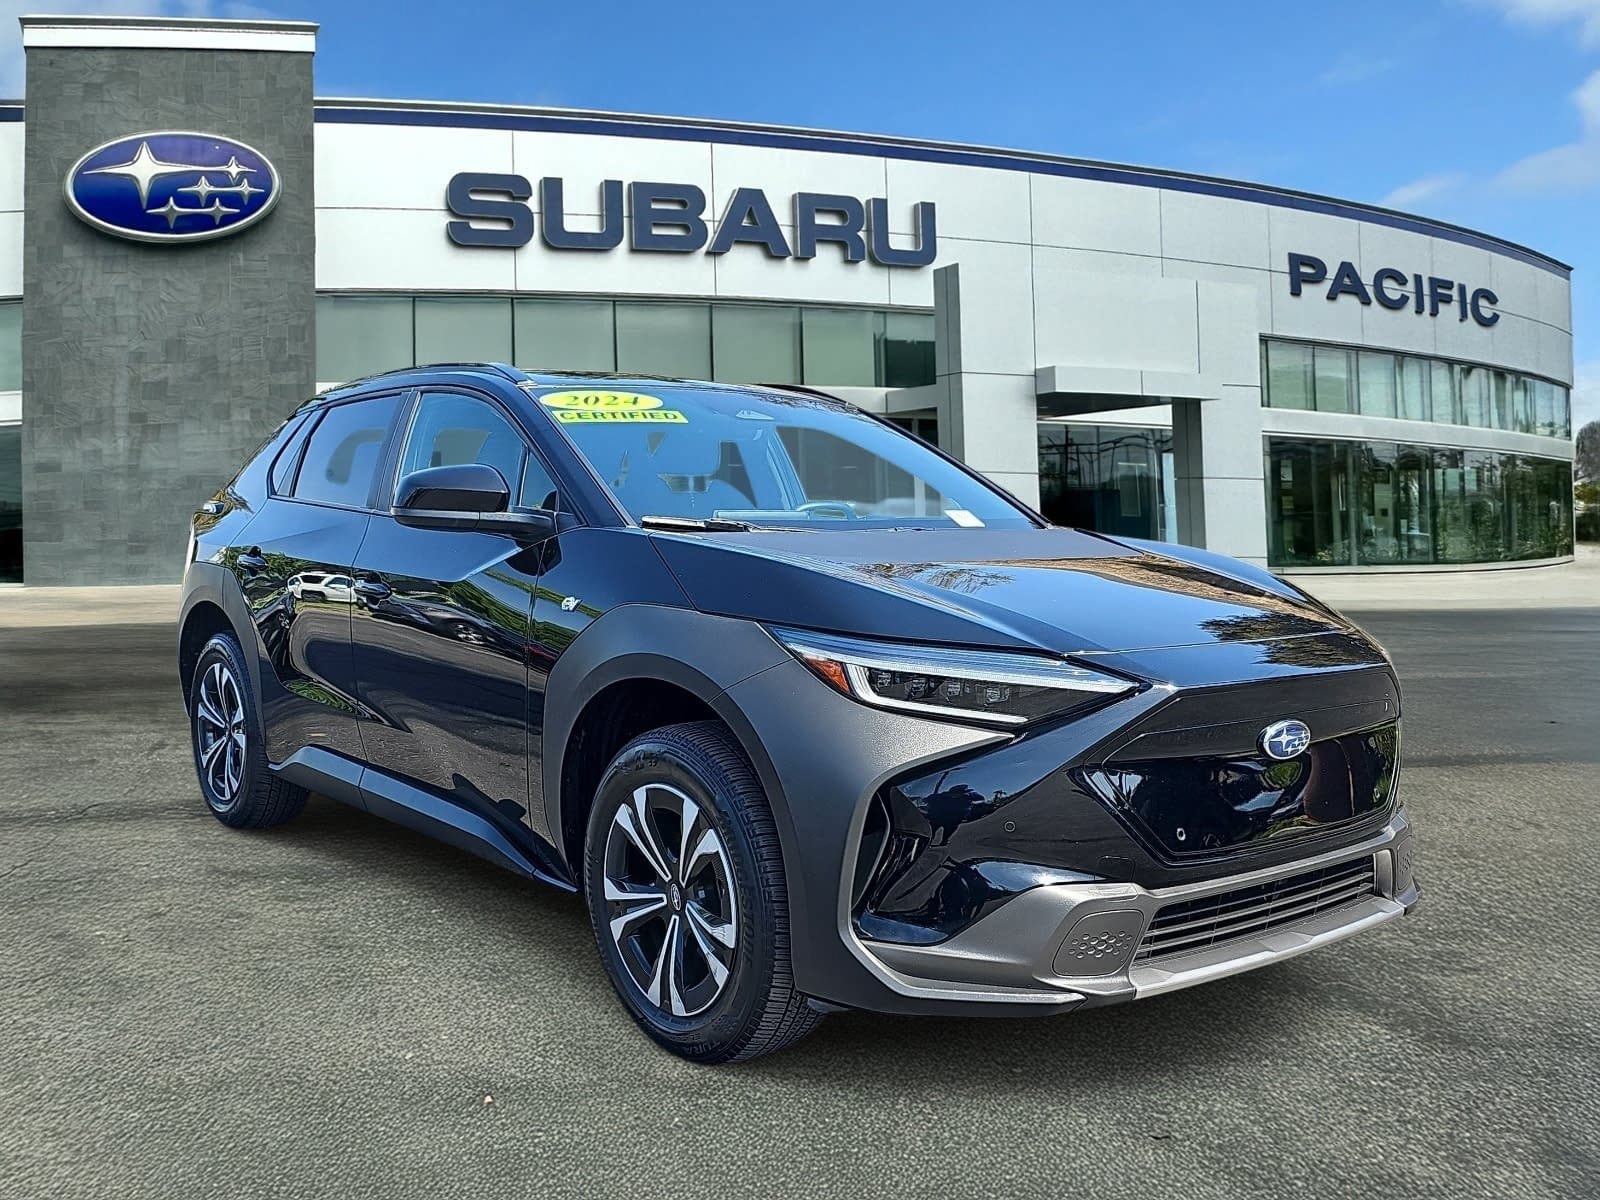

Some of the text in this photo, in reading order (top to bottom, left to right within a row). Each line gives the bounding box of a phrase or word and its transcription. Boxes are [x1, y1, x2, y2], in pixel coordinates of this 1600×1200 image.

[446, 171, 938, 267] SUBARU
[1287, 252, 1500, 327] PACIFIC
[560, 411, 678, 420] CERTIFIED
[565, 395, 640, 406] 2024
